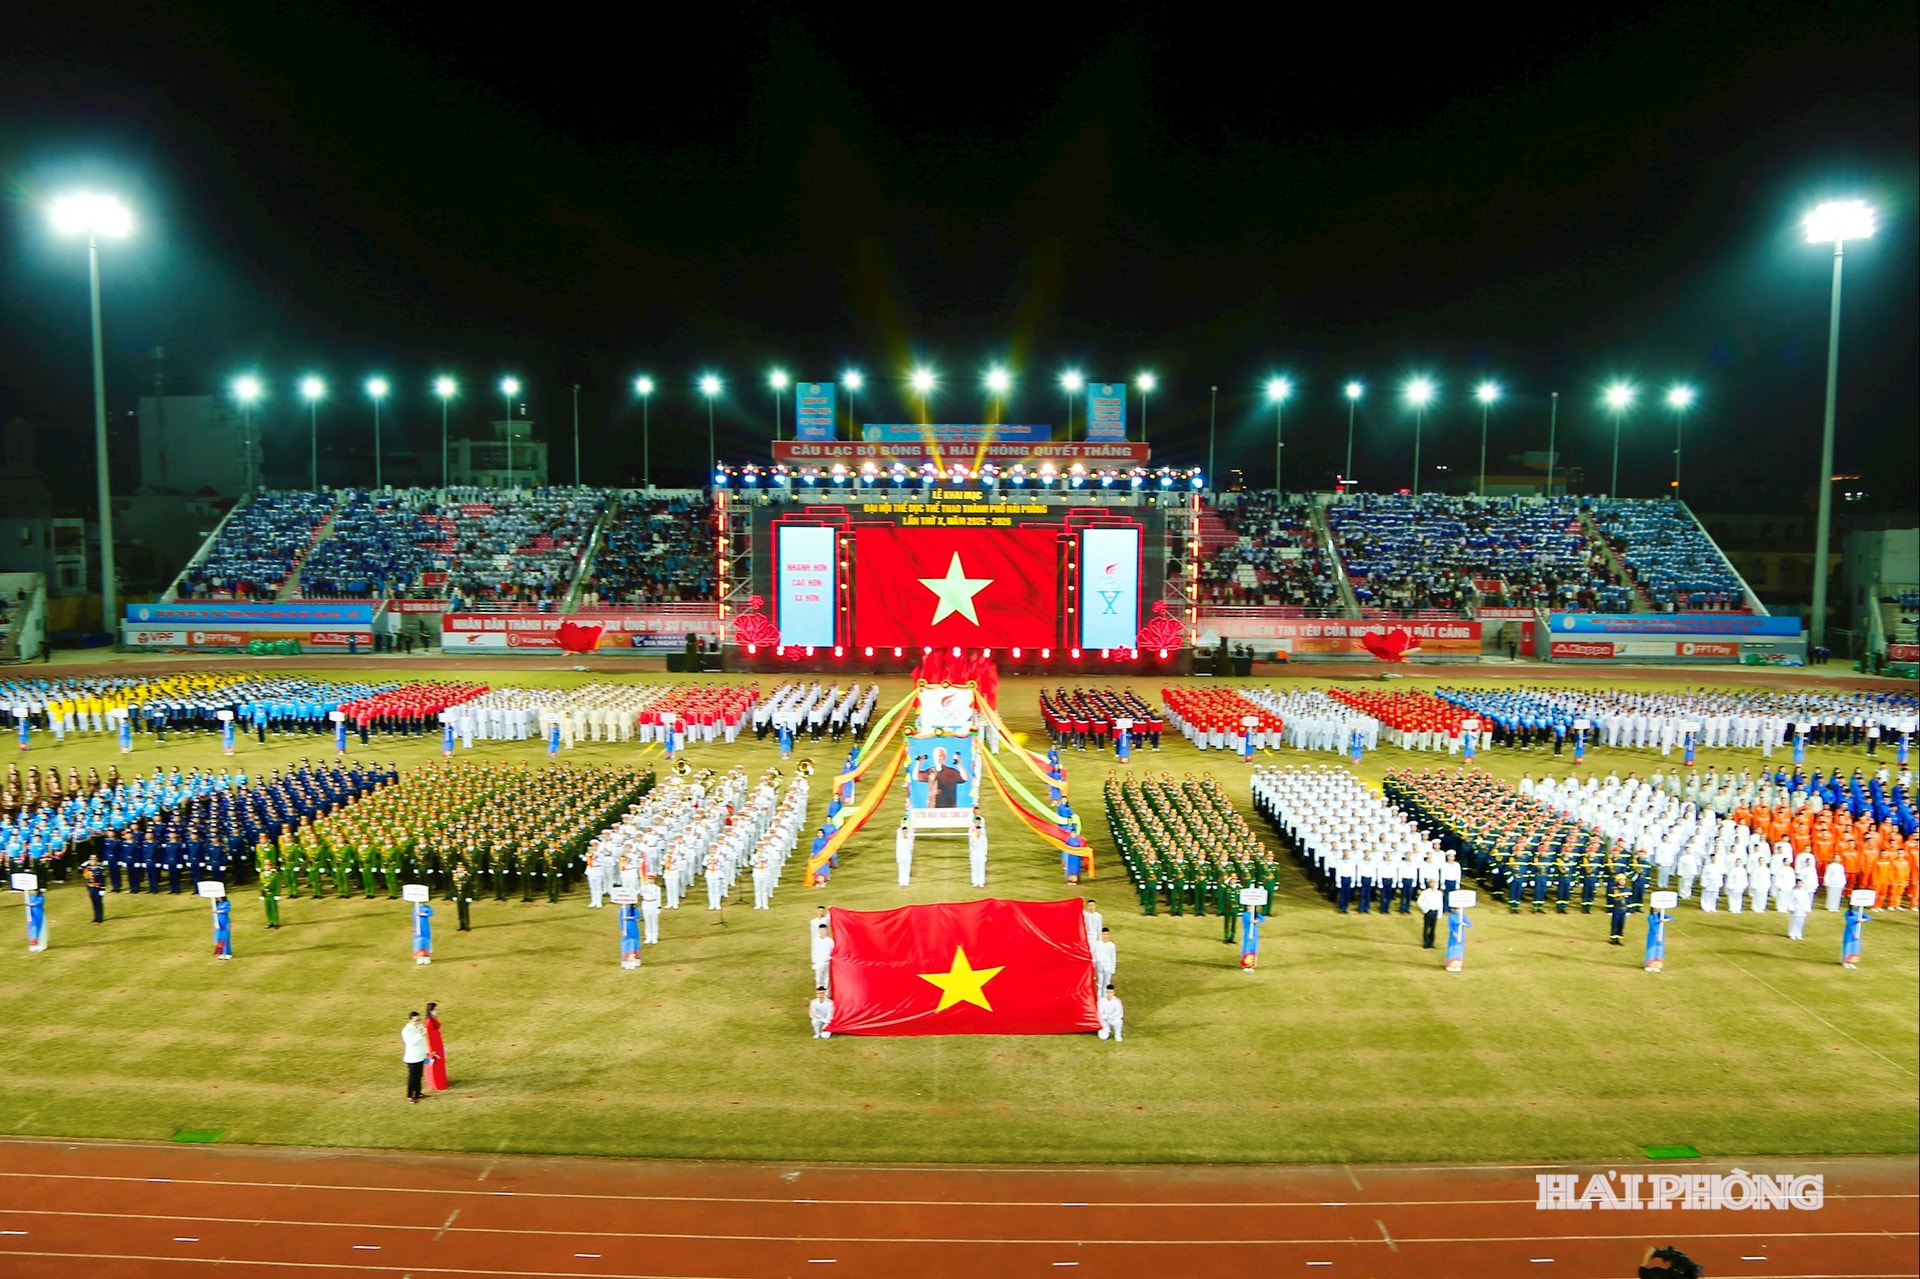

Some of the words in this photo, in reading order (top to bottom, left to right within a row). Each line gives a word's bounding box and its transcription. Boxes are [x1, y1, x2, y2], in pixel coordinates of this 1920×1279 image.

[790, 444, 821, 456] CÂU
[824, 445, 853, 457] LẠC
[856, 444, 877, 457] BỘ
[880, 444, 921, 456] BÓNG
[950, 443, 975, 456] HẢI
[979, 444, 1029, 456] PHÒNG
[1033, 443, 1079, 457] QUYẾT
[943, 490, 963, 500] KHAI
[452, 617, 482, 630] NHÂN
[483, 617, 506, 630] DÂN
[508, 617, 542, 631] THÀNH
[1299, 623, 1320, 637] YÊU
[1323, 622, 1347, 637] CỦA
[1438, 624, 1470, 638] CẢNG
[1569, 645, 1611, 655] Kappa
[1695, 644, 1712, 653] FPT
